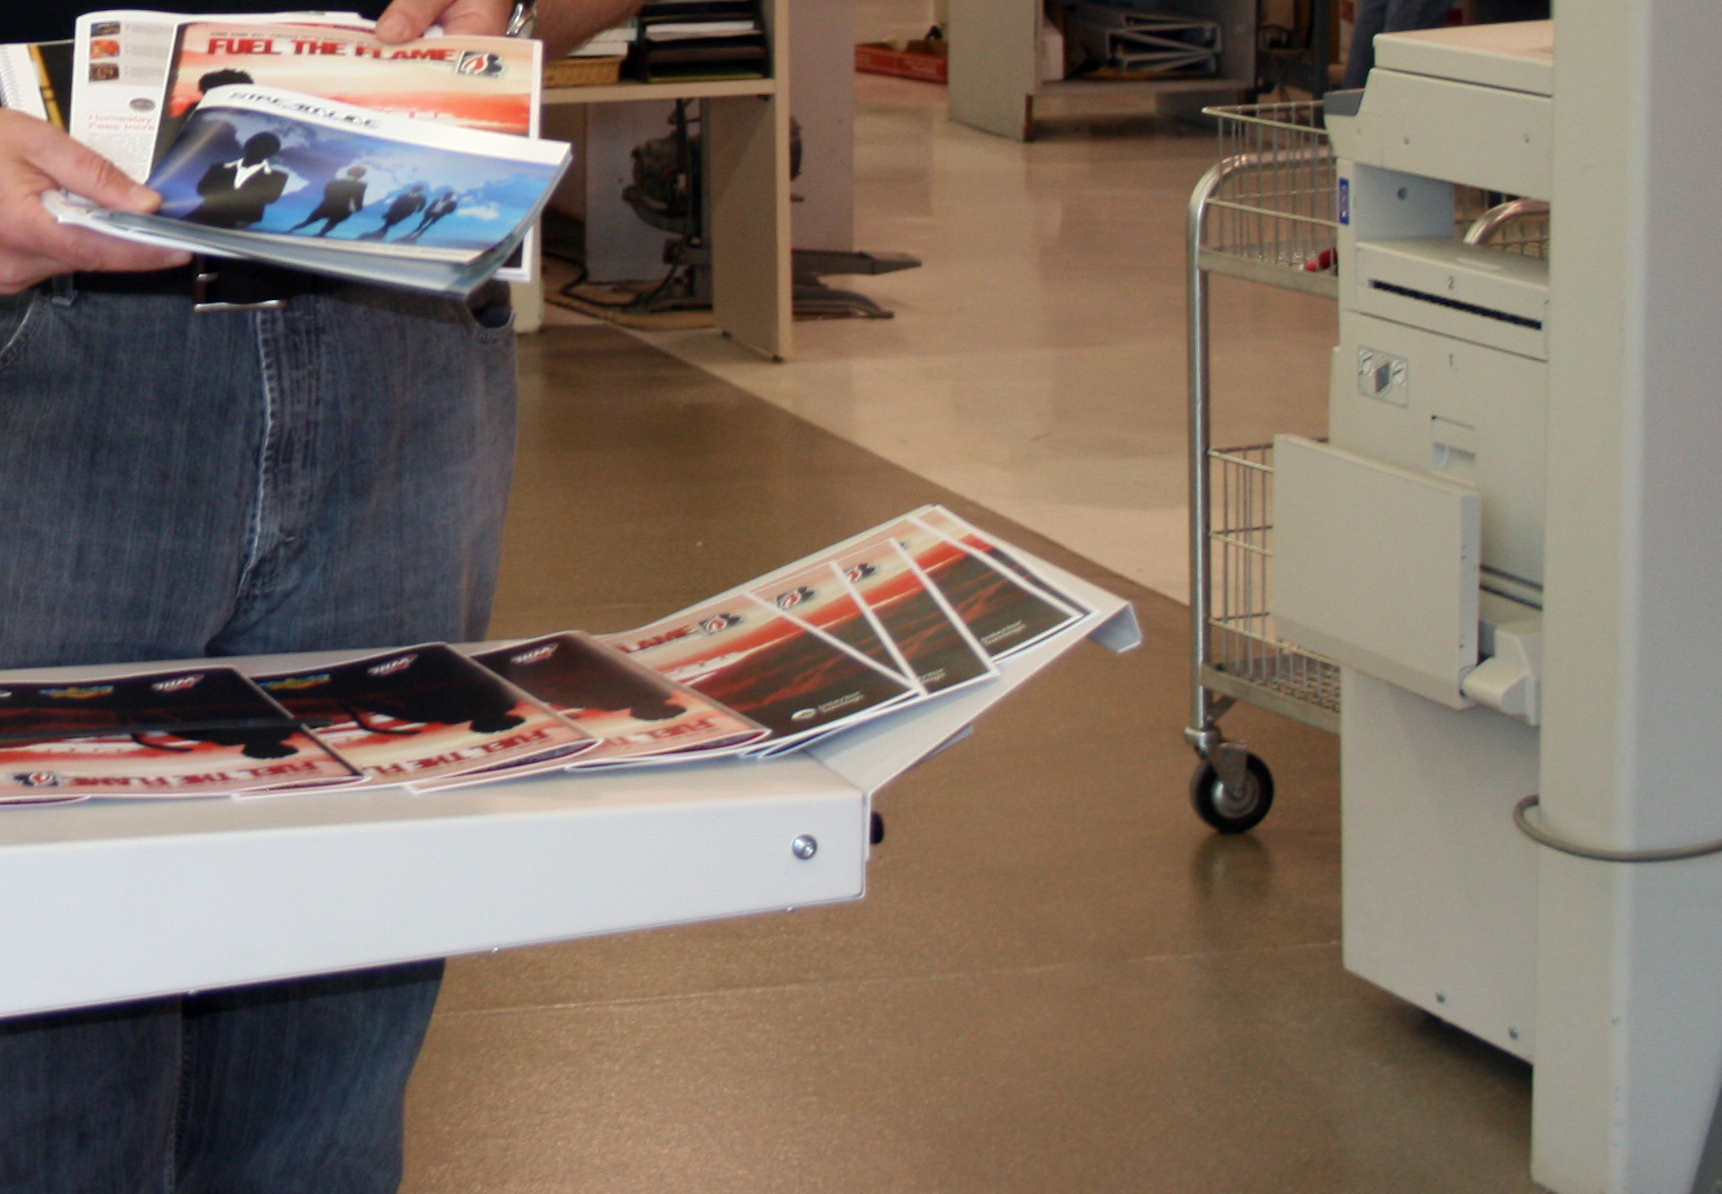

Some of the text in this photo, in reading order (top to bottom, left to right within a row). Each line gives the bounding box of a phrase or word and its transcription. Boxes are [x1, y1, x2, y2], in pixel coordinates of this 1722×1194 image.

[207, 37, 457, 63] FUEL THE FLAME
[1448, 275, 1455, 290] 2
[613, 624, 693, 654] LAME
[639, 718, 714, 740] FUEL
[473, 730, 549, 753] FUEL
[407, 751, 465, 772] THE
[68, 760, 319, 789] FUEL THE FLAME
